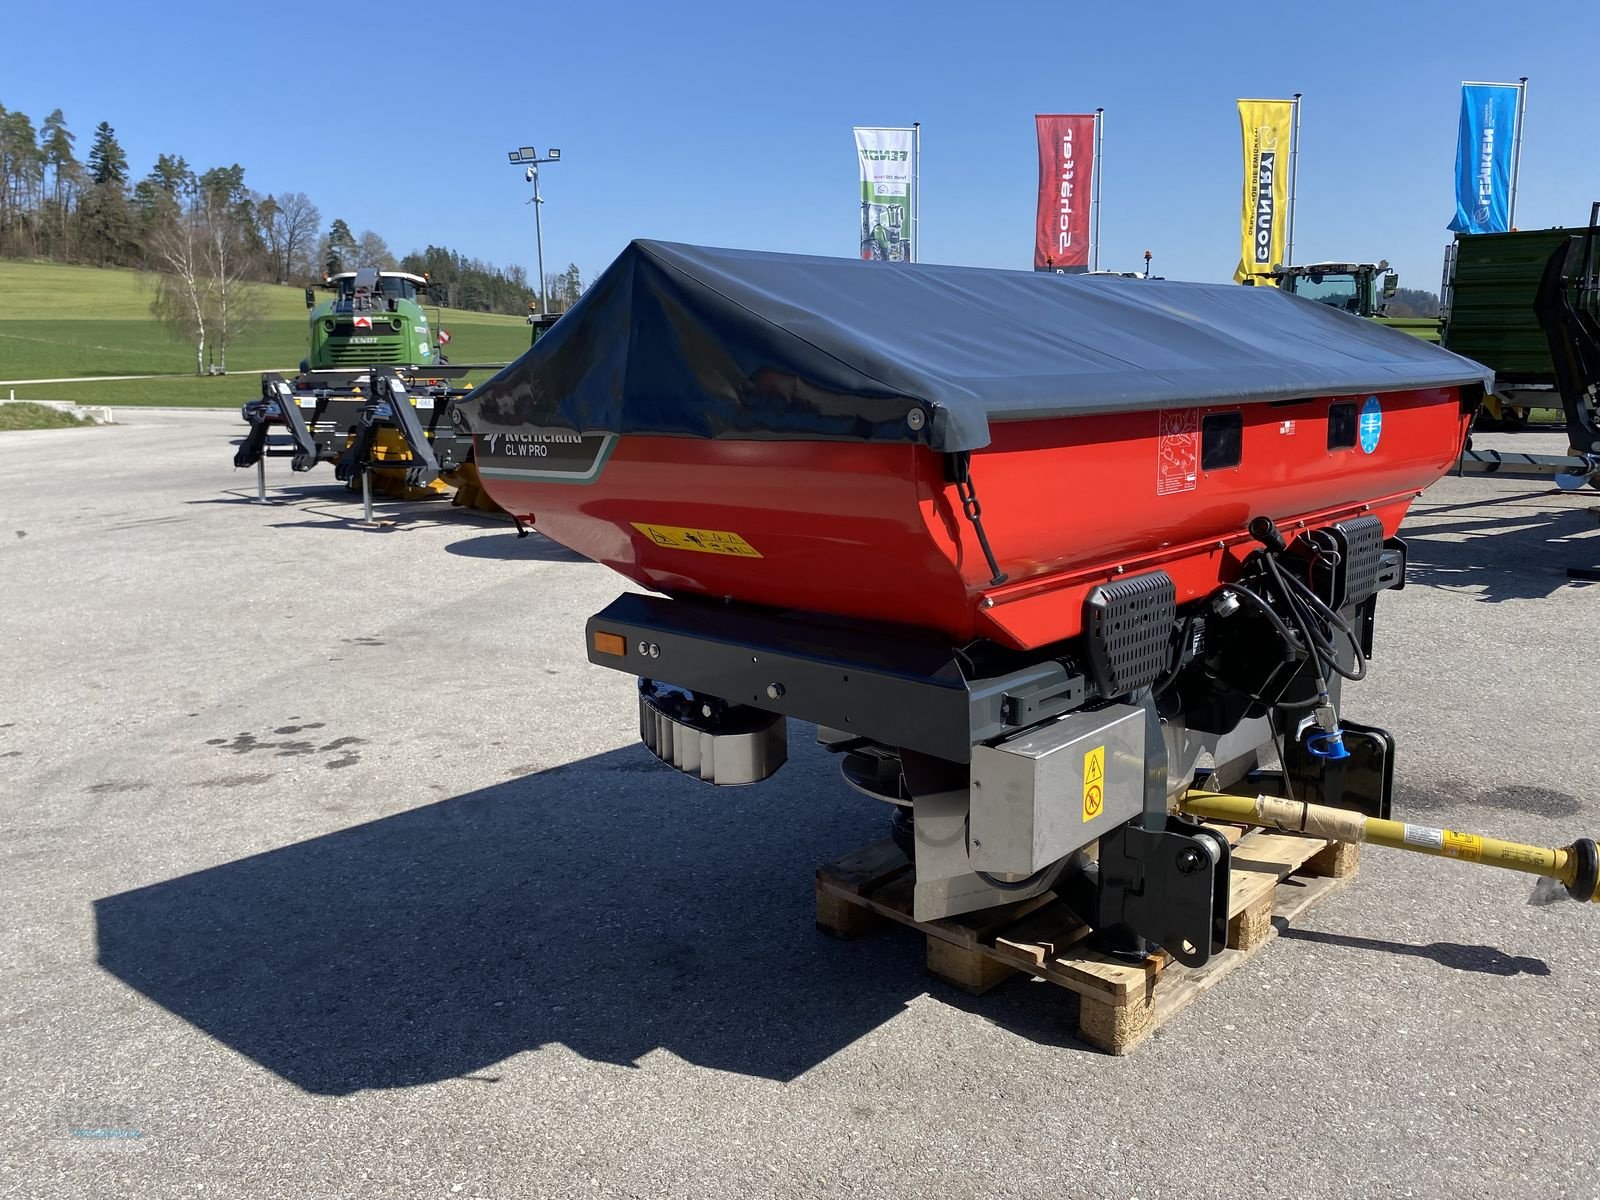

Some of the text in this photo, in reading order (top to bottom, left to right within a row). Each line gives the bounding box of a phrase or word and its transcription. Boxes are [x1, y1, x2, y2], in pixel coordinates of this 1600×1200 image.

[505, 444, 548, 457] CL W PRO
